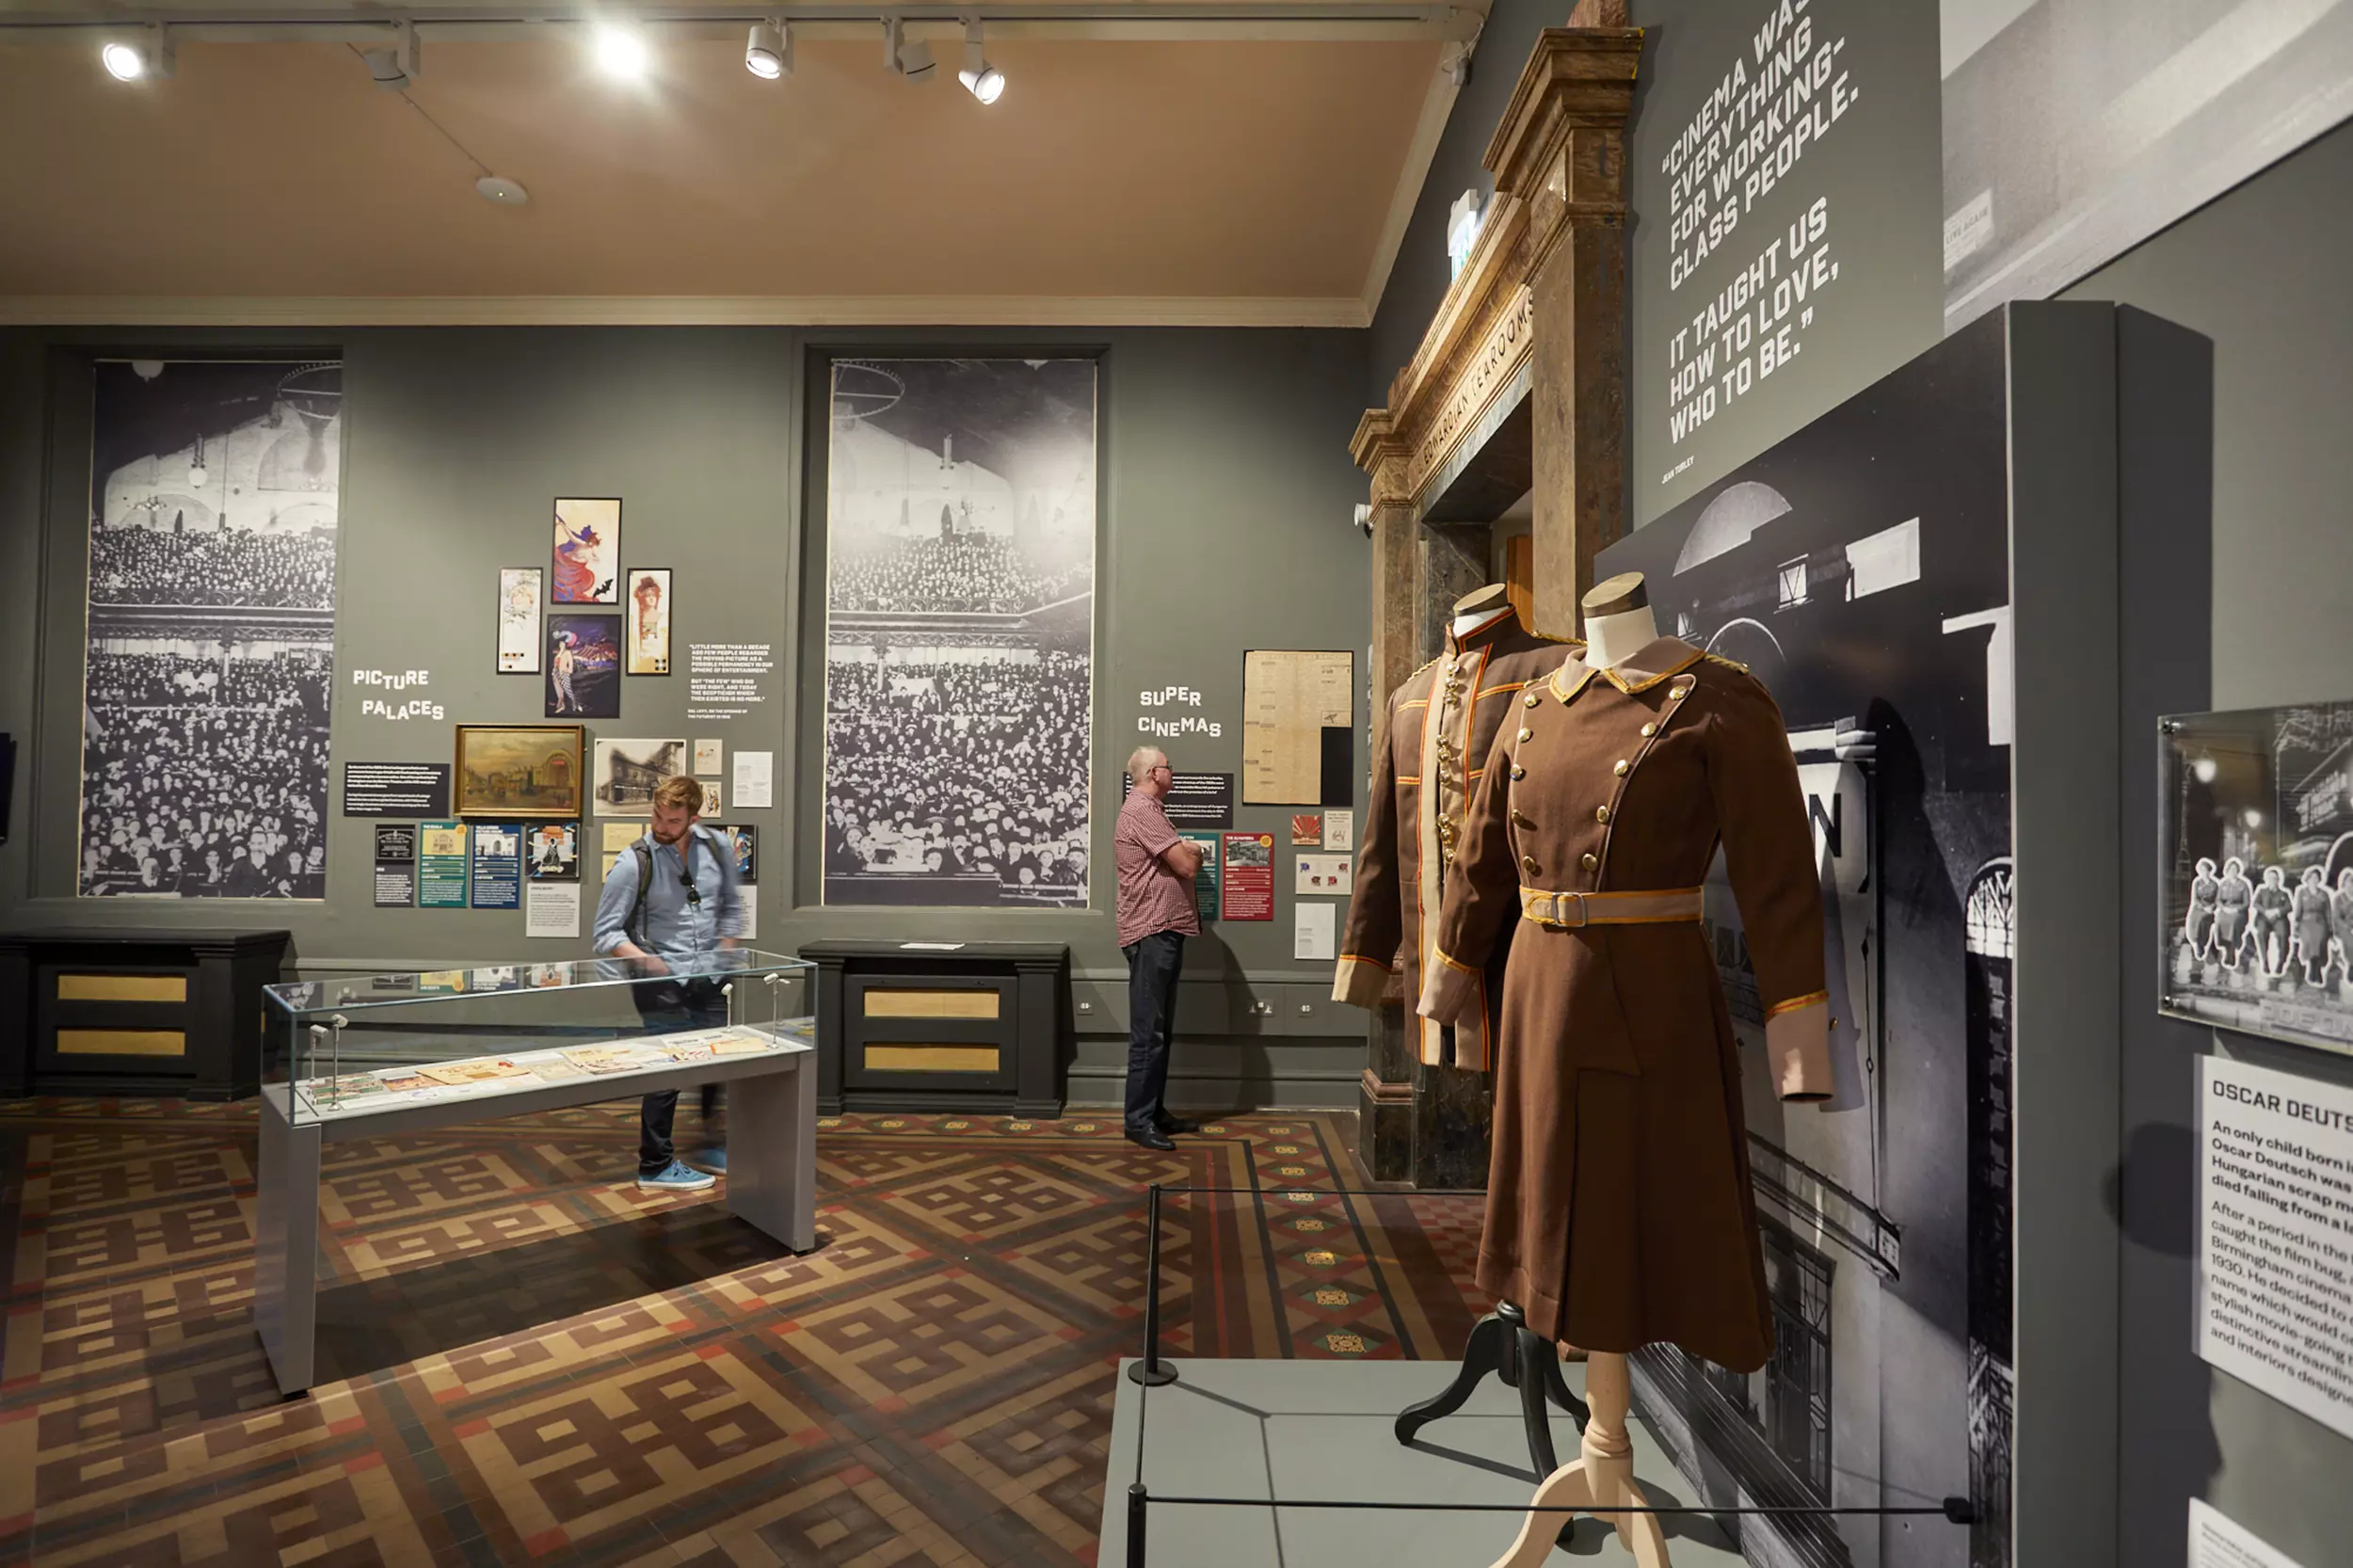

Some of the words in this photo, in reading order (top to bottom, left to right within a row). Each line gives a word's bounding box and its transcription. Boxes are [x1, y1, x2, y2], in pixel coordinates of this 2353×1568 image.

[1671, 15, 1812, 216] EVERYTHING
[1671, 188, 1706, 254] FOR
[1713, 36, 1845, 202] WORKING-
[1671, 195, 1738, 292] CLASS
[1745, 70, 1859, 214] PEOPLE.
[1671, 328, 1688, 369] IT
[1692, 237, 1782, 346] TAUGHT
[1789, 196, 1827, 260] US
[1671, 343, 1716, 408] HOW
[1721, 312, 1752, 362] TO
[1759, 242, 1839, 334] LOVE,
[1423, 392, 1469, 465] EDWARDIAN
[1670, 385, 1716, 444] WHO
[1721, 357, 1752, 405] TO
[353, 669, 429, 690] PICTURE
[361, 699, 444, 720] PALACES
[1140, 686, 1201, 707] SUPER
[1138, 716, 1222, 737] CINEMAS
[2213, 1080, 2281, 1113] OSCAR
[2212, 1120, 2232, 1136] An
[2233, 1128, 2264, 1146] only
[2265, 1138, 2303, 1158] child
[2306, 1148, 2344, 1172] born
[2346, 1160, 2353, 1175] i
[2212, 1137, 2252, 1160] Oscar
[2255, 1151, 2317, 1183] Deutsch
[2320, 1176, 2352, 1194] was
[2212, 1155, 2286, 1191] Hungarian
[2288, 1182, 2332, 1208] scrap
[2212, 1174, 2241, 1193] died
[2244, 1184, 2289, 1214] falling
[2291, 1201, 2329, 1225] from
[2331, 1219, 2341, 1229] a
[2211, 1200, 2245, 1222] After
[2248, 1217, 2256, 1226] a
[2258, 1220, 2305, 1246] period
[2307, 1237, 2321, 1252] in
[2324, 1243, 2348, 1263] the
[2211, 1221, 2257, 1246] caught
[2259, 1239, 2282, 1256] the
[2284, 1248, 2312, 1269] film
[2313, 1257, 2346, 1285] bug,
[2211, 1235, 2295, 1280] Birmingham
[2297, 1272, 2351, 1305] cinema
[2211, 1253, 2246, 1279] 1930.
[2248, 1268, 2267, 1288] He
[2269, 1279, 2329, 1315] decided
[2331, 1305, 2346, 1321] to
[2211, 1273, 2248, 1296] name
[2250, 1290, 2291, 1318] which
[2294, 1310, 2338, 1339] would
[2211, 1289, 2254, 1320] stylish
[2255, 1309, 2345, 1365] movie-going
[2211, 1306, 2281, 1350] distinctive
[2282, 1343, 2353, 1388] streamlin
[2211, 1328, 2236, 1347] and
[2237, 1337, 2296, 1377] interiors
